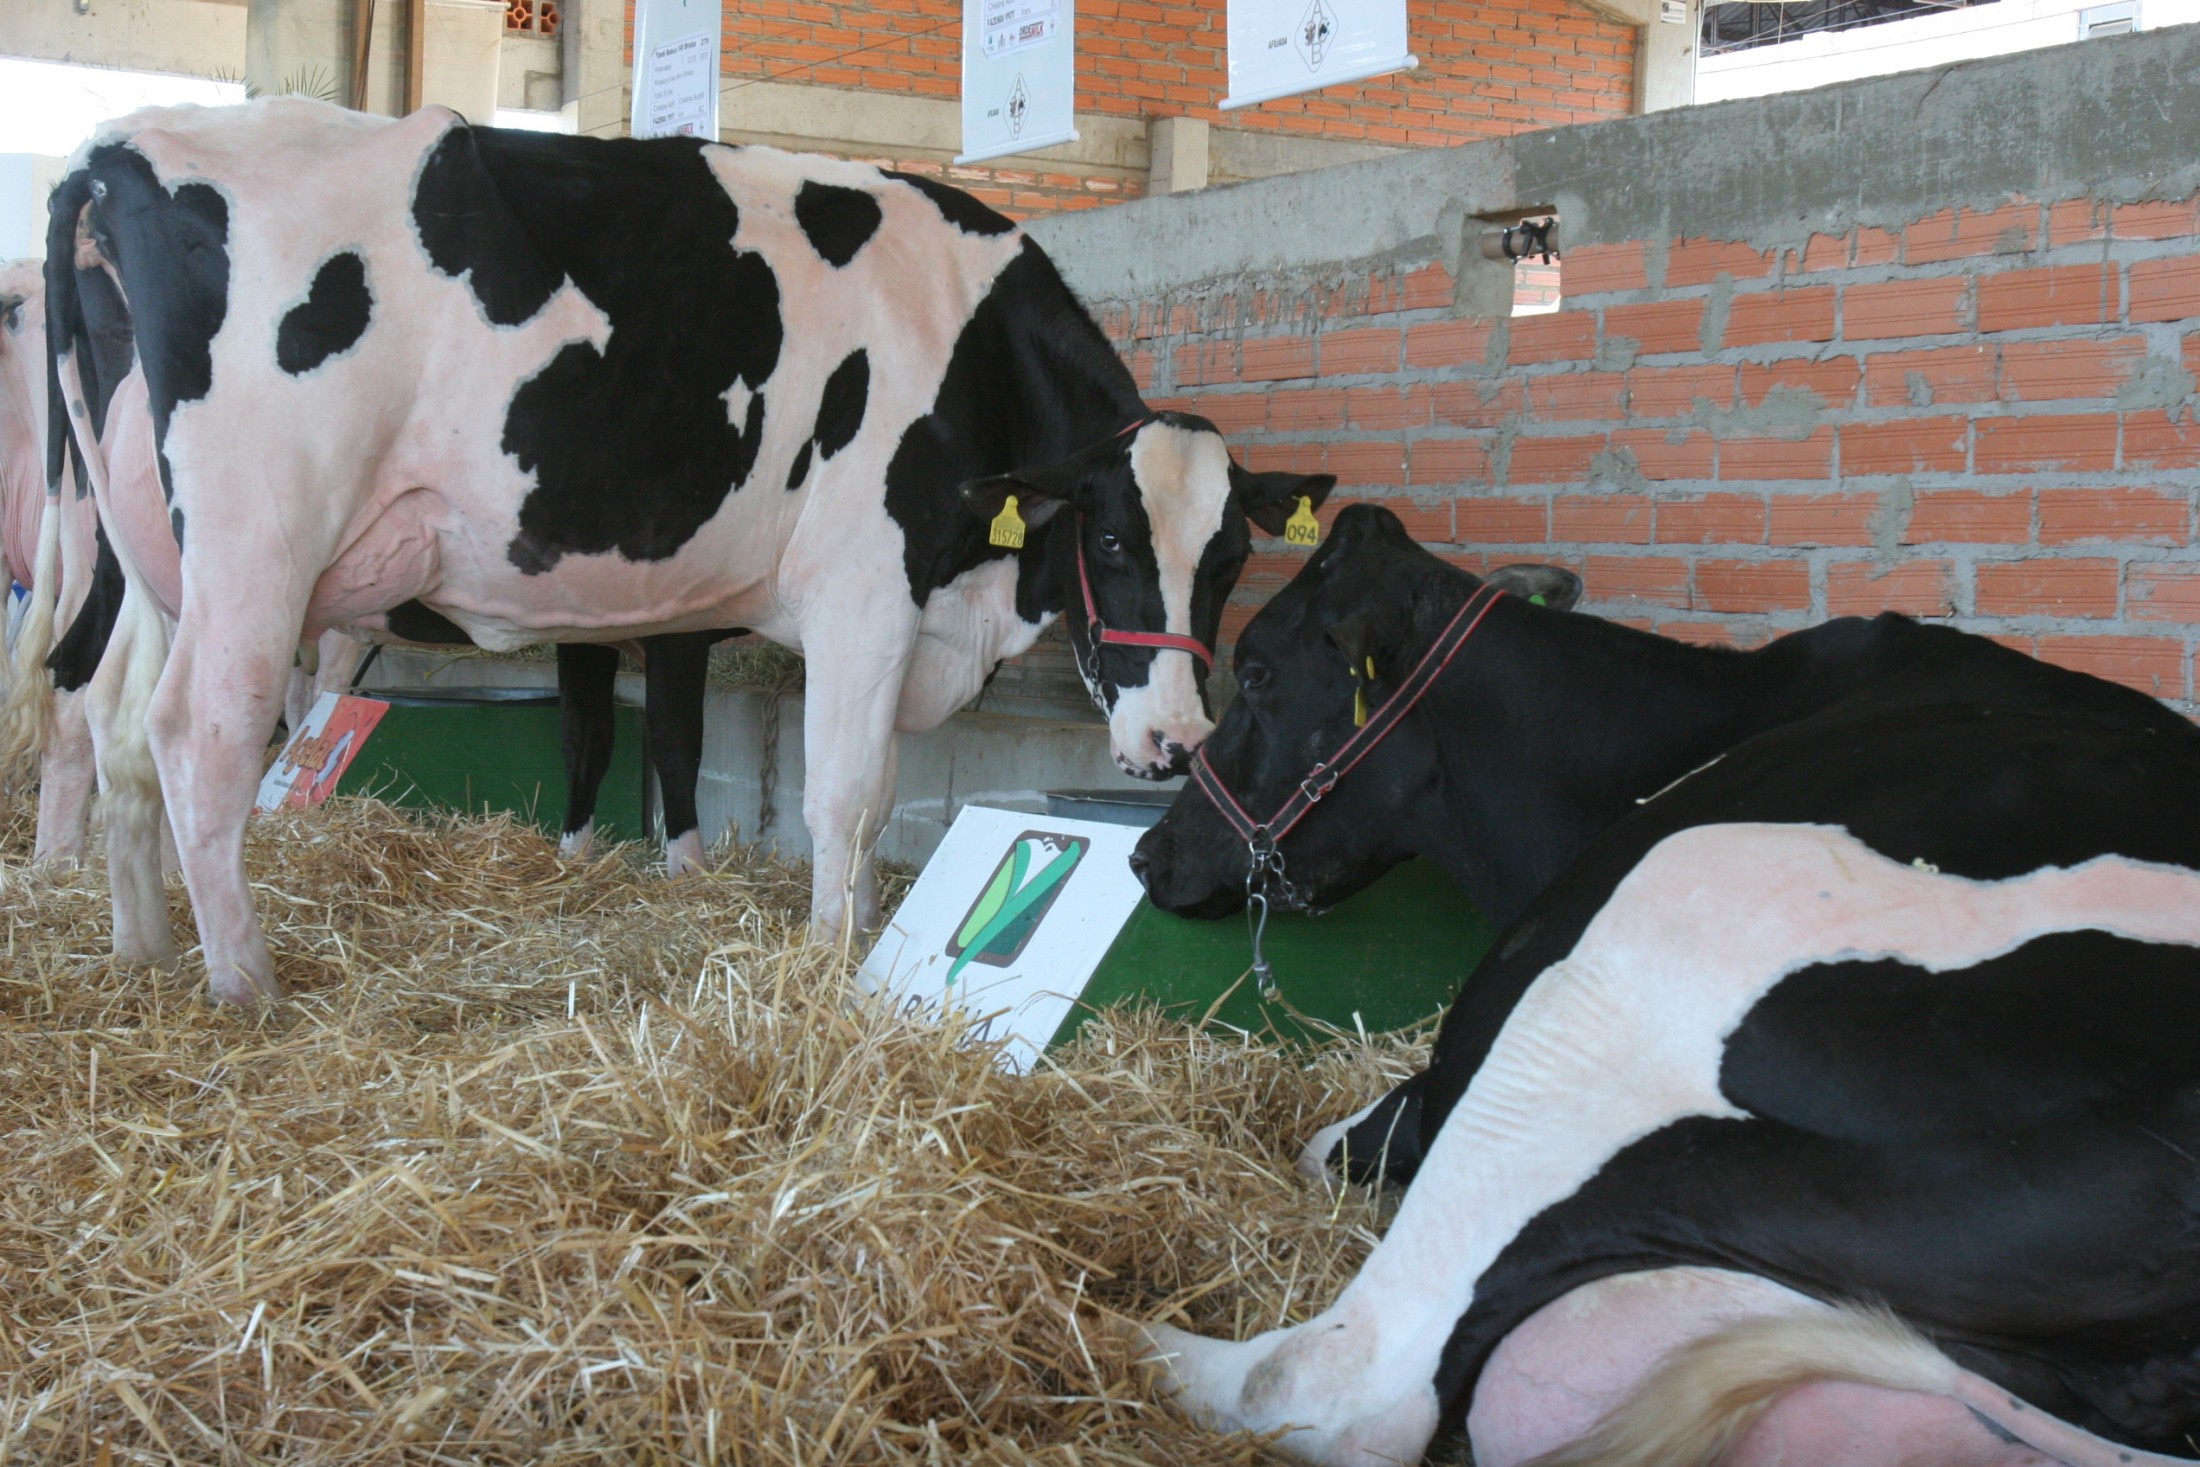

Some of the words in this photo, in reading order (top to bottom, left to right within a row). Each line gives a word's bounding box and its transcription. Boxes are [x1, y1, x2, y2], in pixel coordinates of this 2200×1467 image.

[1019, 20, 1044, 37] ORDEMILK
[991, 528, 1023, 547] 315728
[1287, 524, 1317, 544] 094
